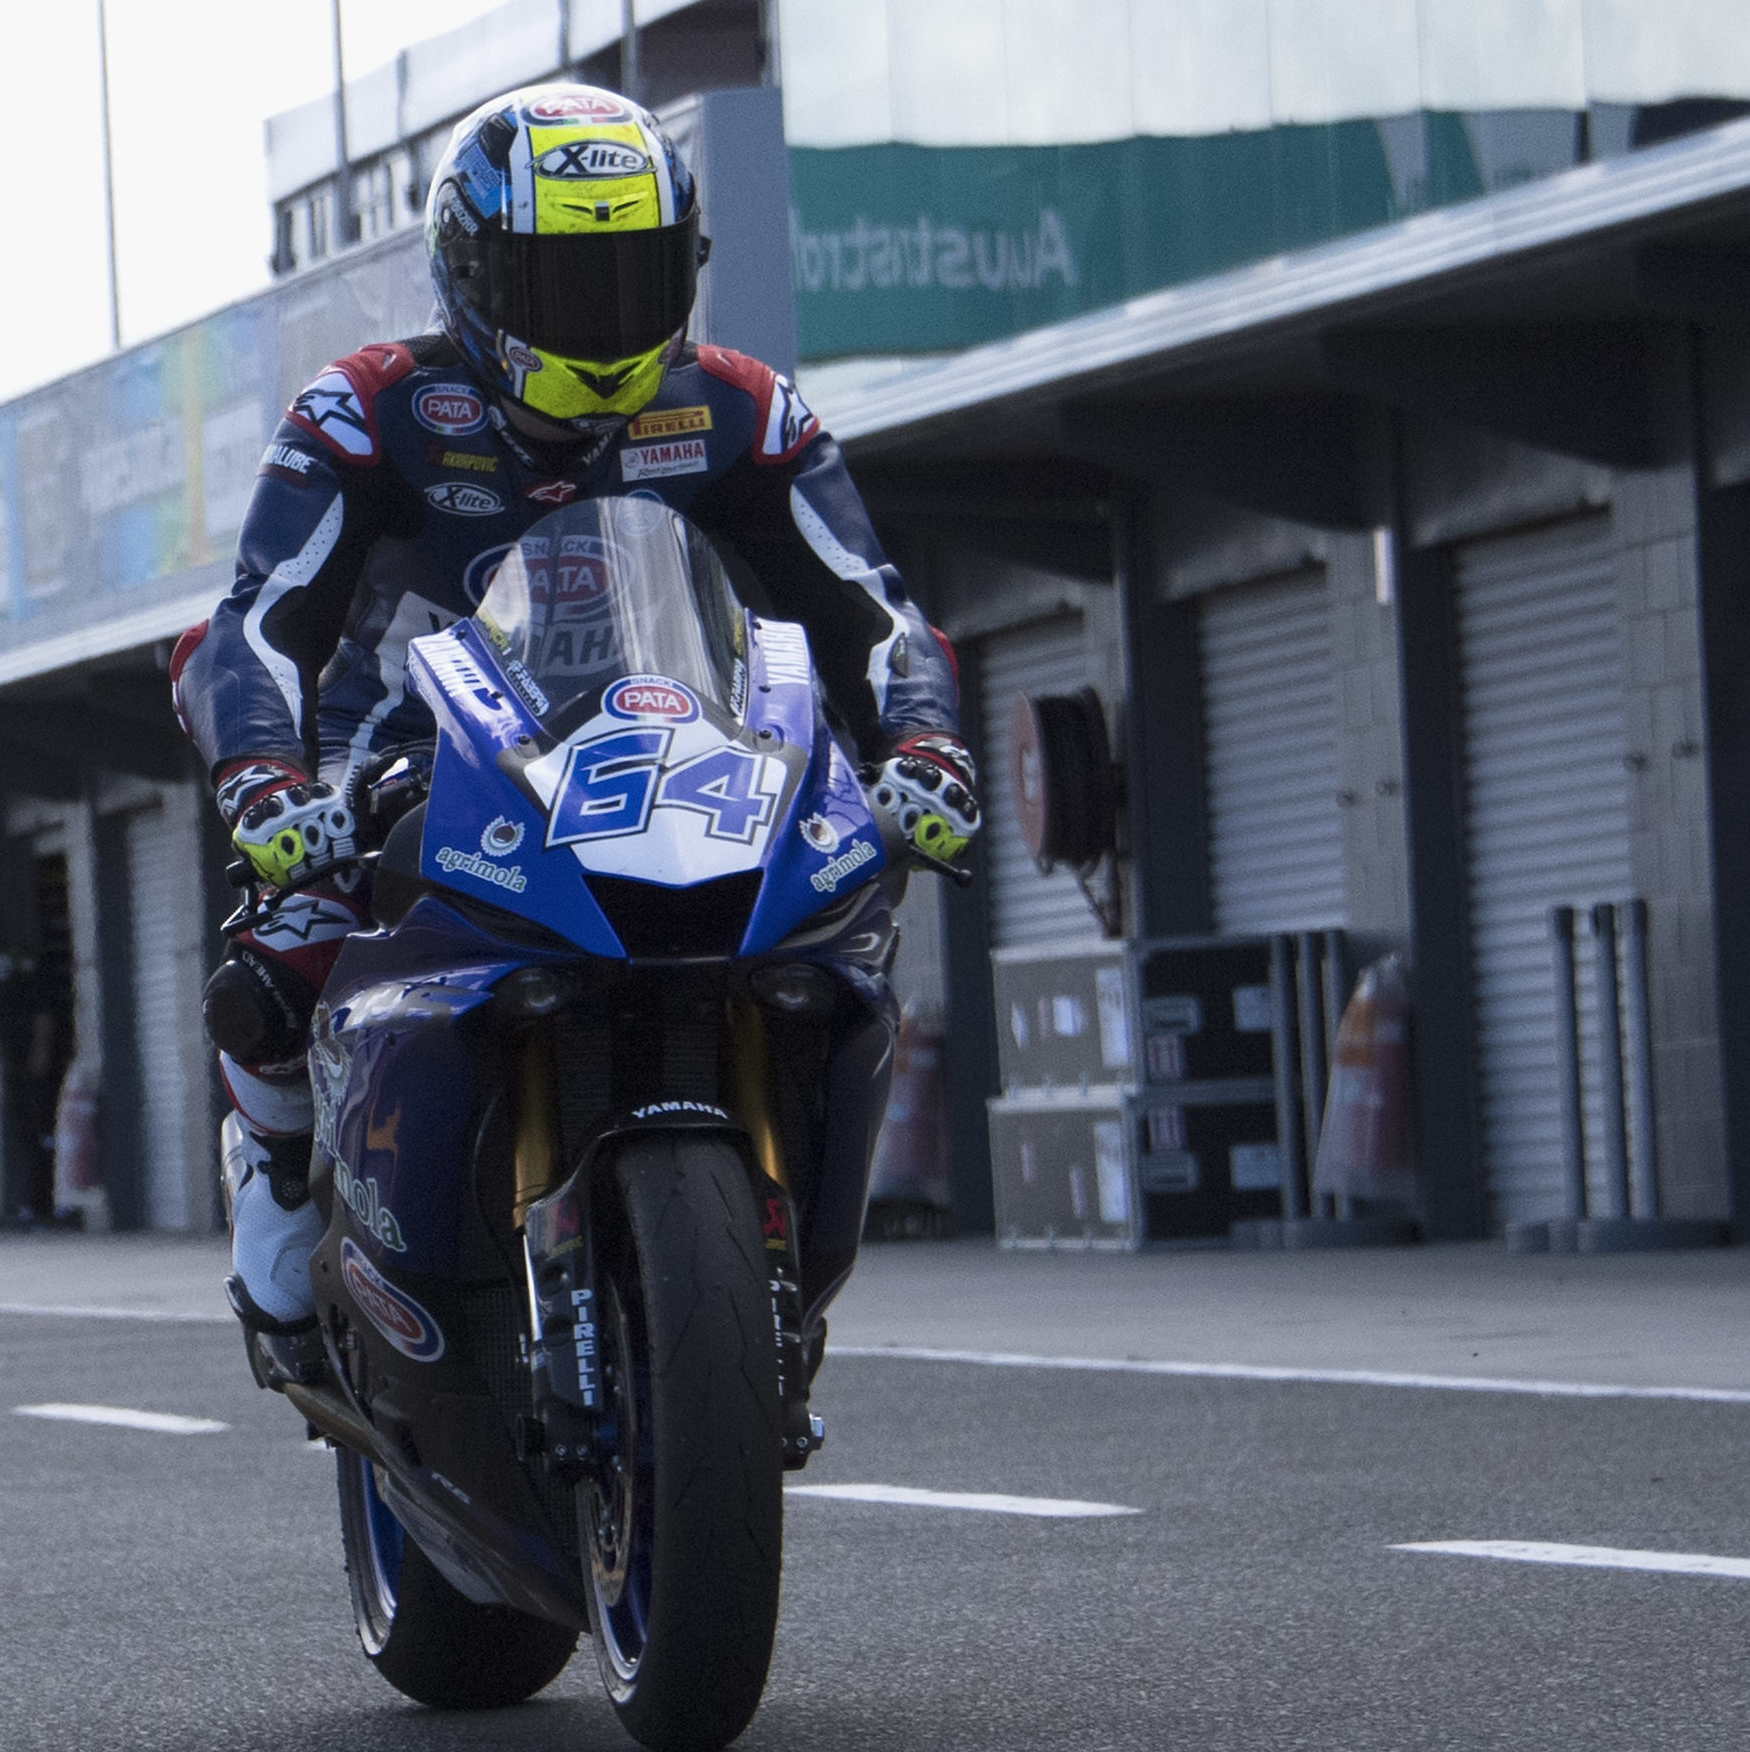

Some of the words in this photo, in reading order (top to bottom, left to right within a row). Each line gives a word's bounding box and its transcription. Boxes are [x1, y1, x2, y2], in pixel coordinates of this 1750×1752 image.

[542, 97, 613, 115] PATA
[553, 145, 639, 175] X-lite
[427, 399, 473, 419] PATA
[633, 410, 706, 437] PIRELLI
[640, 441, 705, 466] YAMAHA
[441, 486, 491, 509] X-lite
[629, 676, 673, 688] SNACK
[623, 690, 682, 712] PATA
[544, 727, 776, 849] 64
[436, 847, 527, 893] agrimola
[811, 839, 877, 892] agrimola
[631, 1101, 729, 1120] YAMAHA
[570, 1288, 595, 1407] PIRELLI
